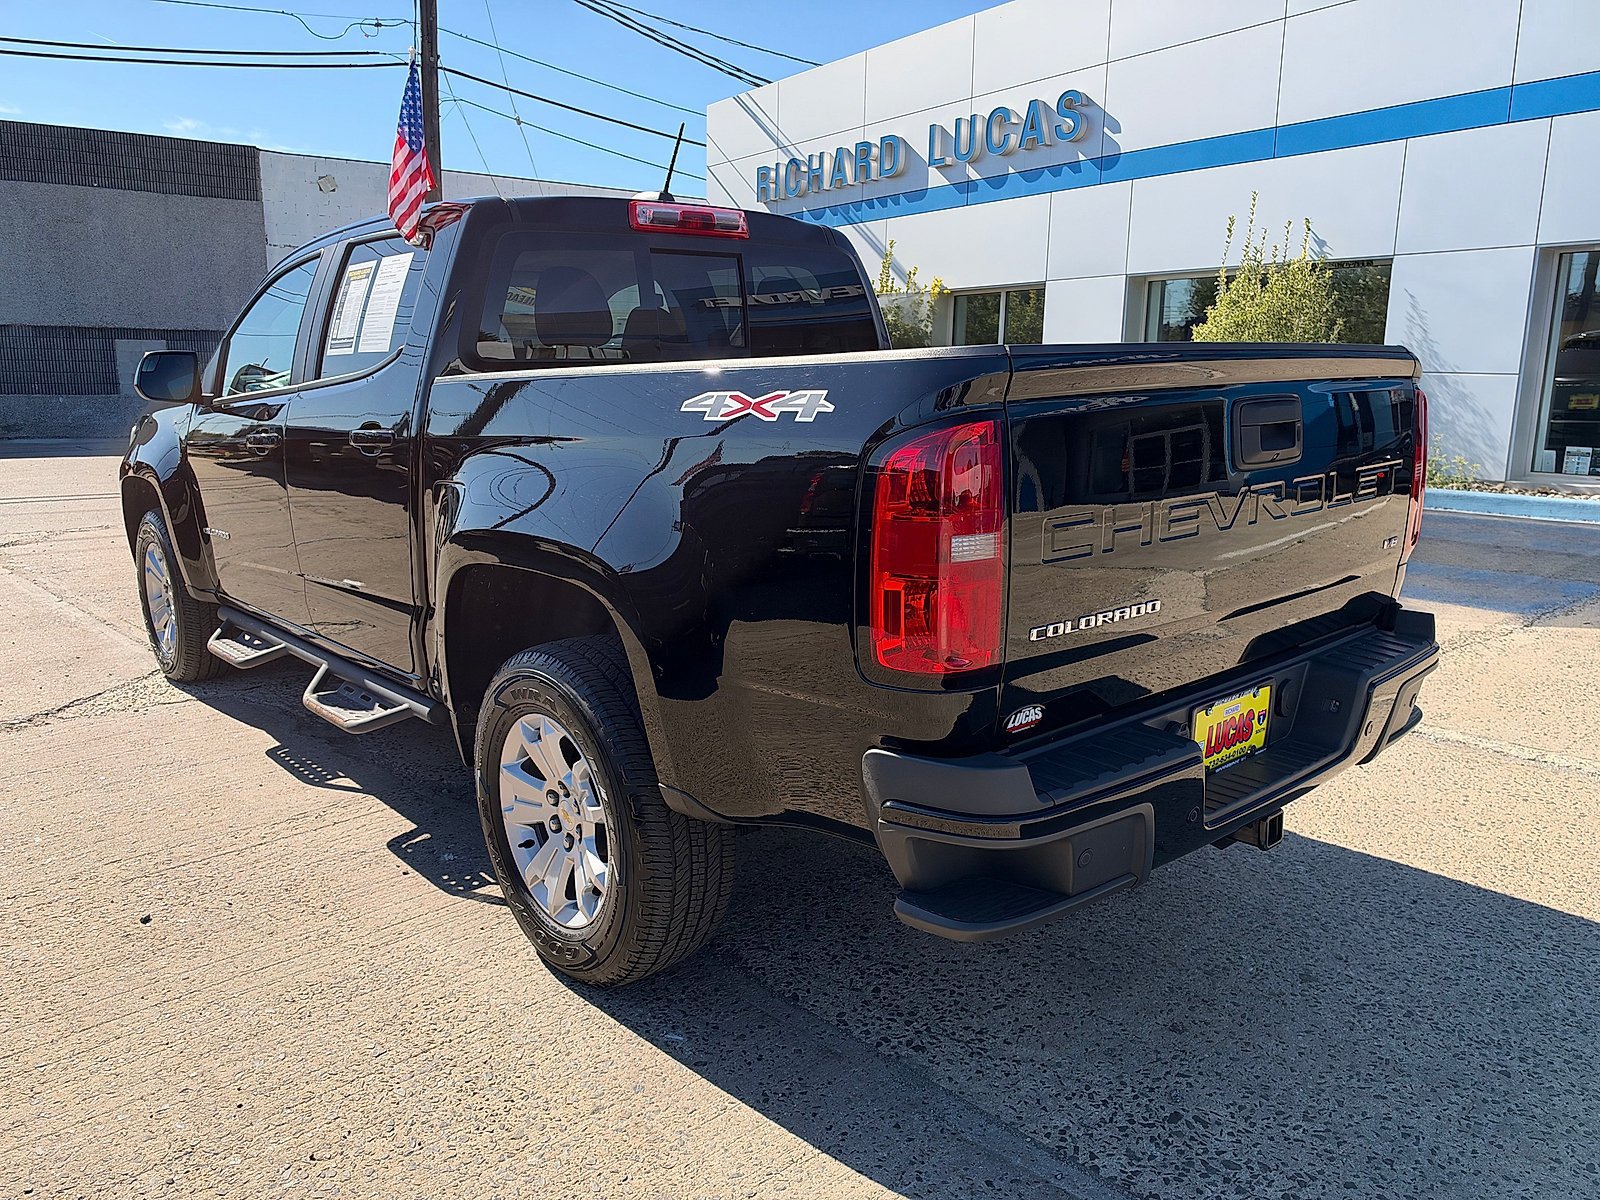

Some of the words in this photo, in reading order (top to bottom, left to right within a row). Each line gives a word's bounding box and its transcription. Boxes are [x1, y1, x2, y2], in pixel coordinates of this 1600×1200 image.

[756, 134, 907, 203] RICHARD
[928, 89, 1090, 167] LUCAS
[1041, 459, 1403, 564] CHEVROLET
[1029, 599, 1162, 642] COLORADO
[1006, 706, 1043, 730] LUCAS
[1205, 709, 1255, 759] LUCAS
